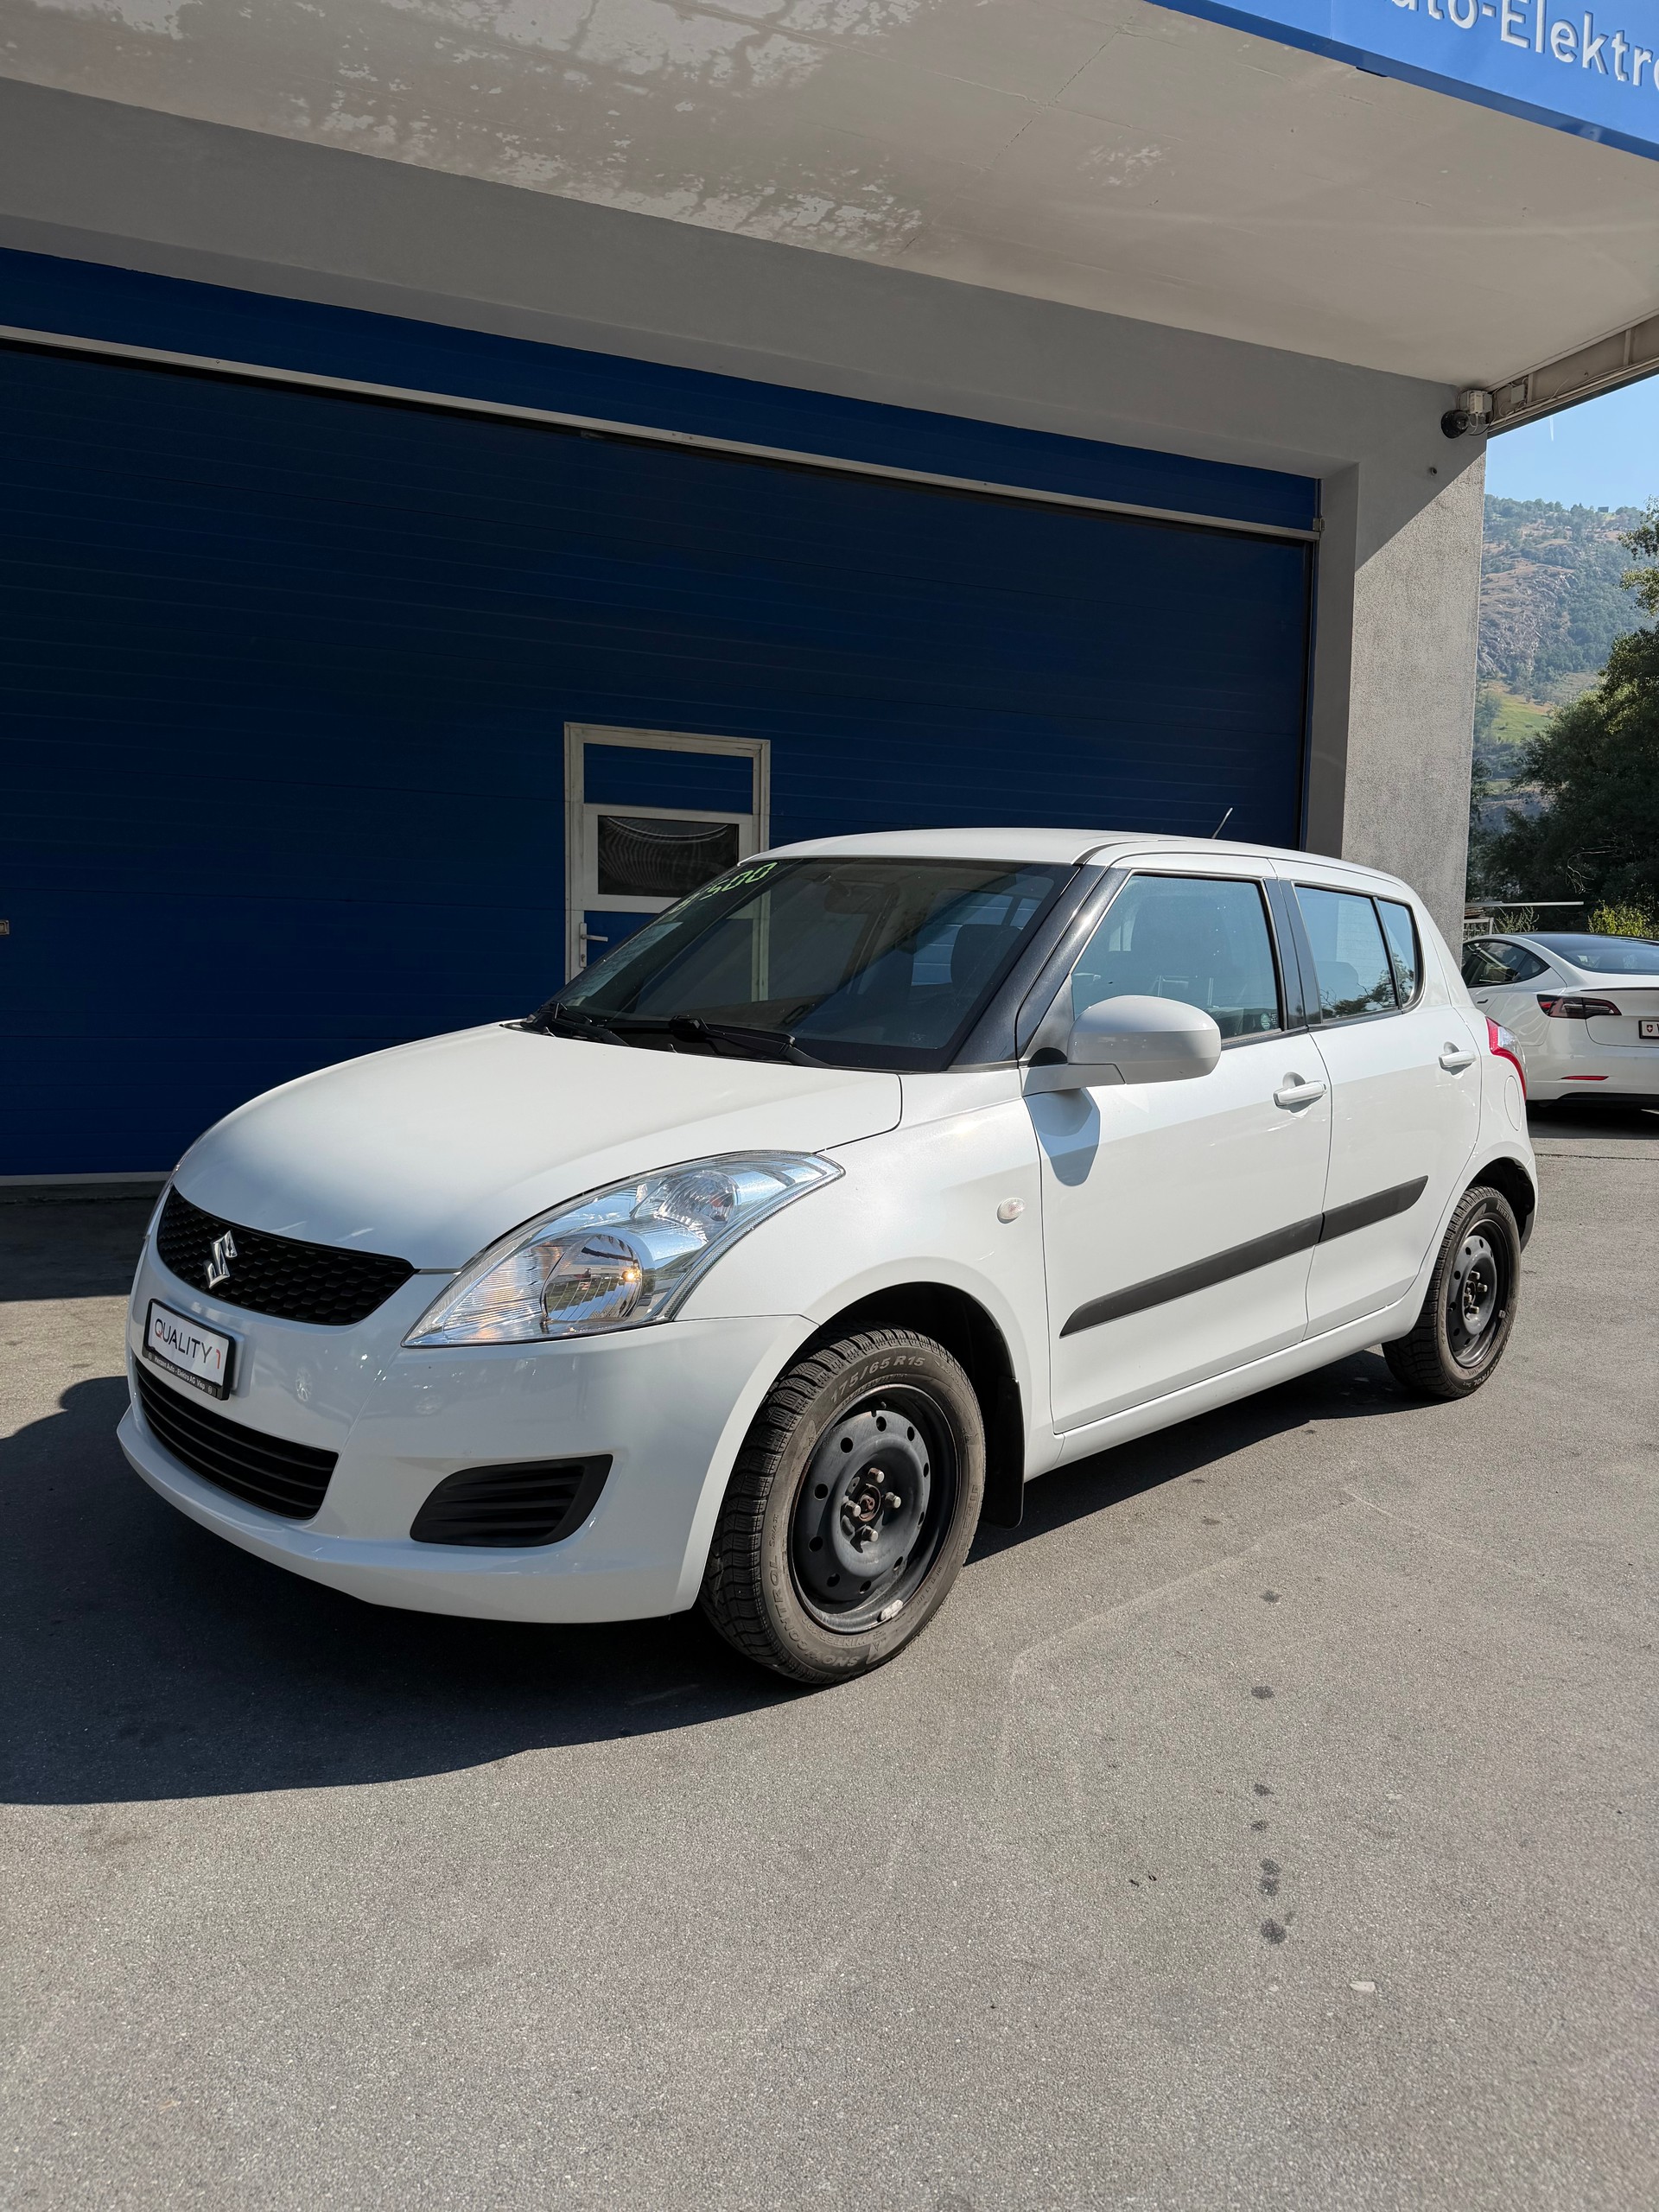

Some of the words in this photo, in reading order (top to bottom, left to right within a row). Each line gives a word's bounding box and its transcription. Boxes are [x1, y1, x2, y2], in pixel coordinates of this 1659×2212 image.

[1392, 0, 1659, 92] o-Elektr
[155, 1319, 213, 1363] QUALITY
[215, 1348, 221, 1370] 1
[831, 1357, 891, 1403] 175/65
[893, 1355, 925, 1367] R15
